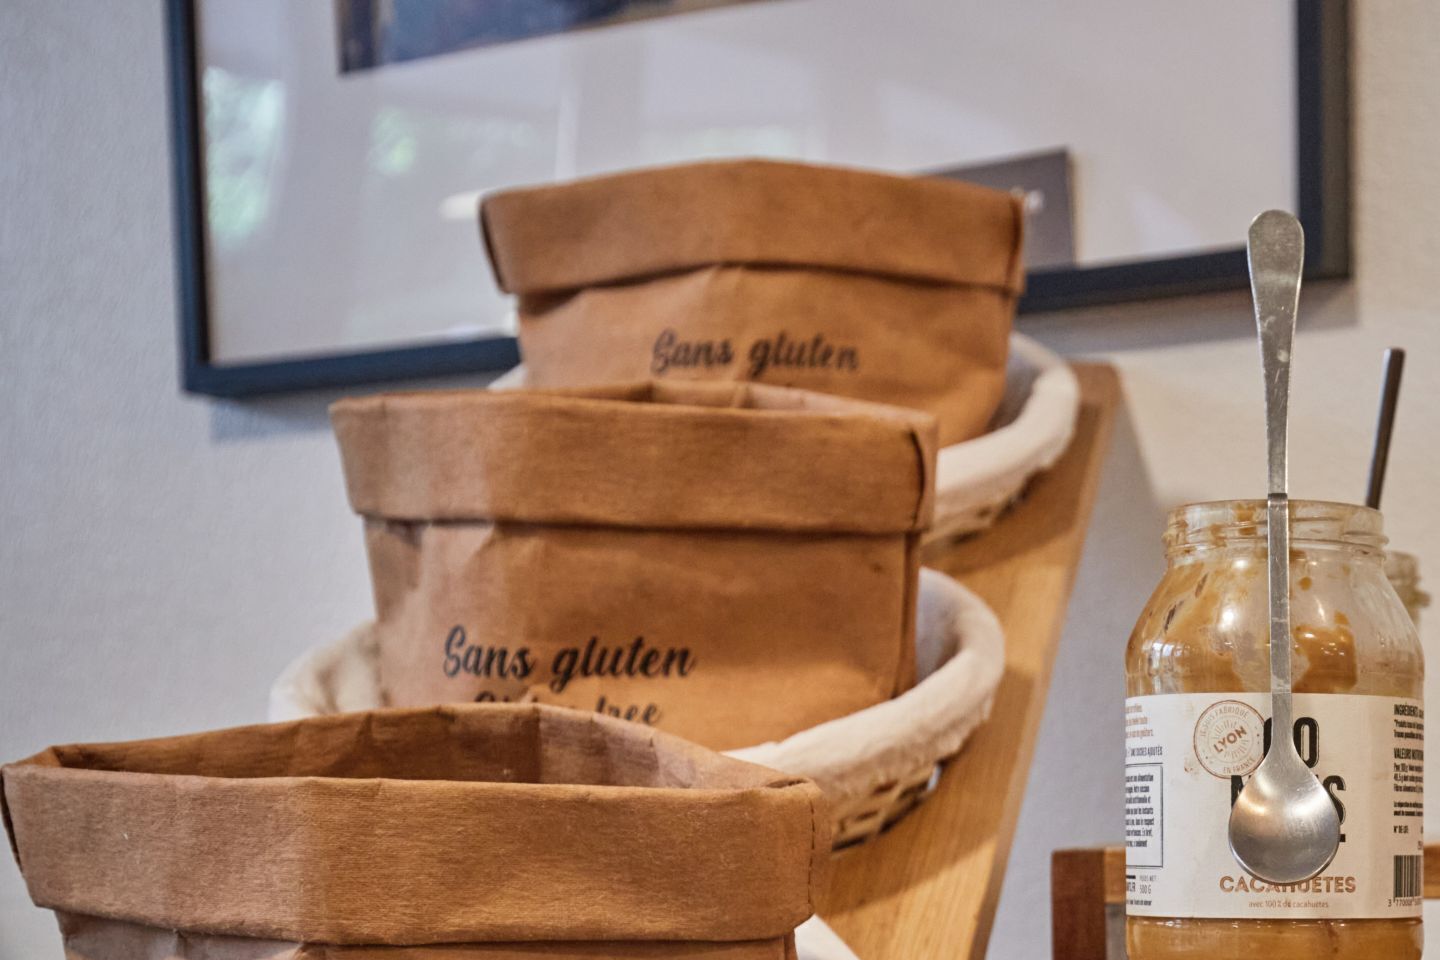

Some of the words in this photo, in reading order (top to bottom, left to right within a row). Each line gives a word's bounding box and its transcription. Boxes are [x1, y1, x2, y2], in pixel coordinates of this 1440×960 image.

[651, 328, 733, 377] Sans
[747, 331, 860, 381] gluten
[443, 624, 535, 679] Sans
[549, 636, 697, 694] gluten
[1213, 725, 1247, 753] LYON
